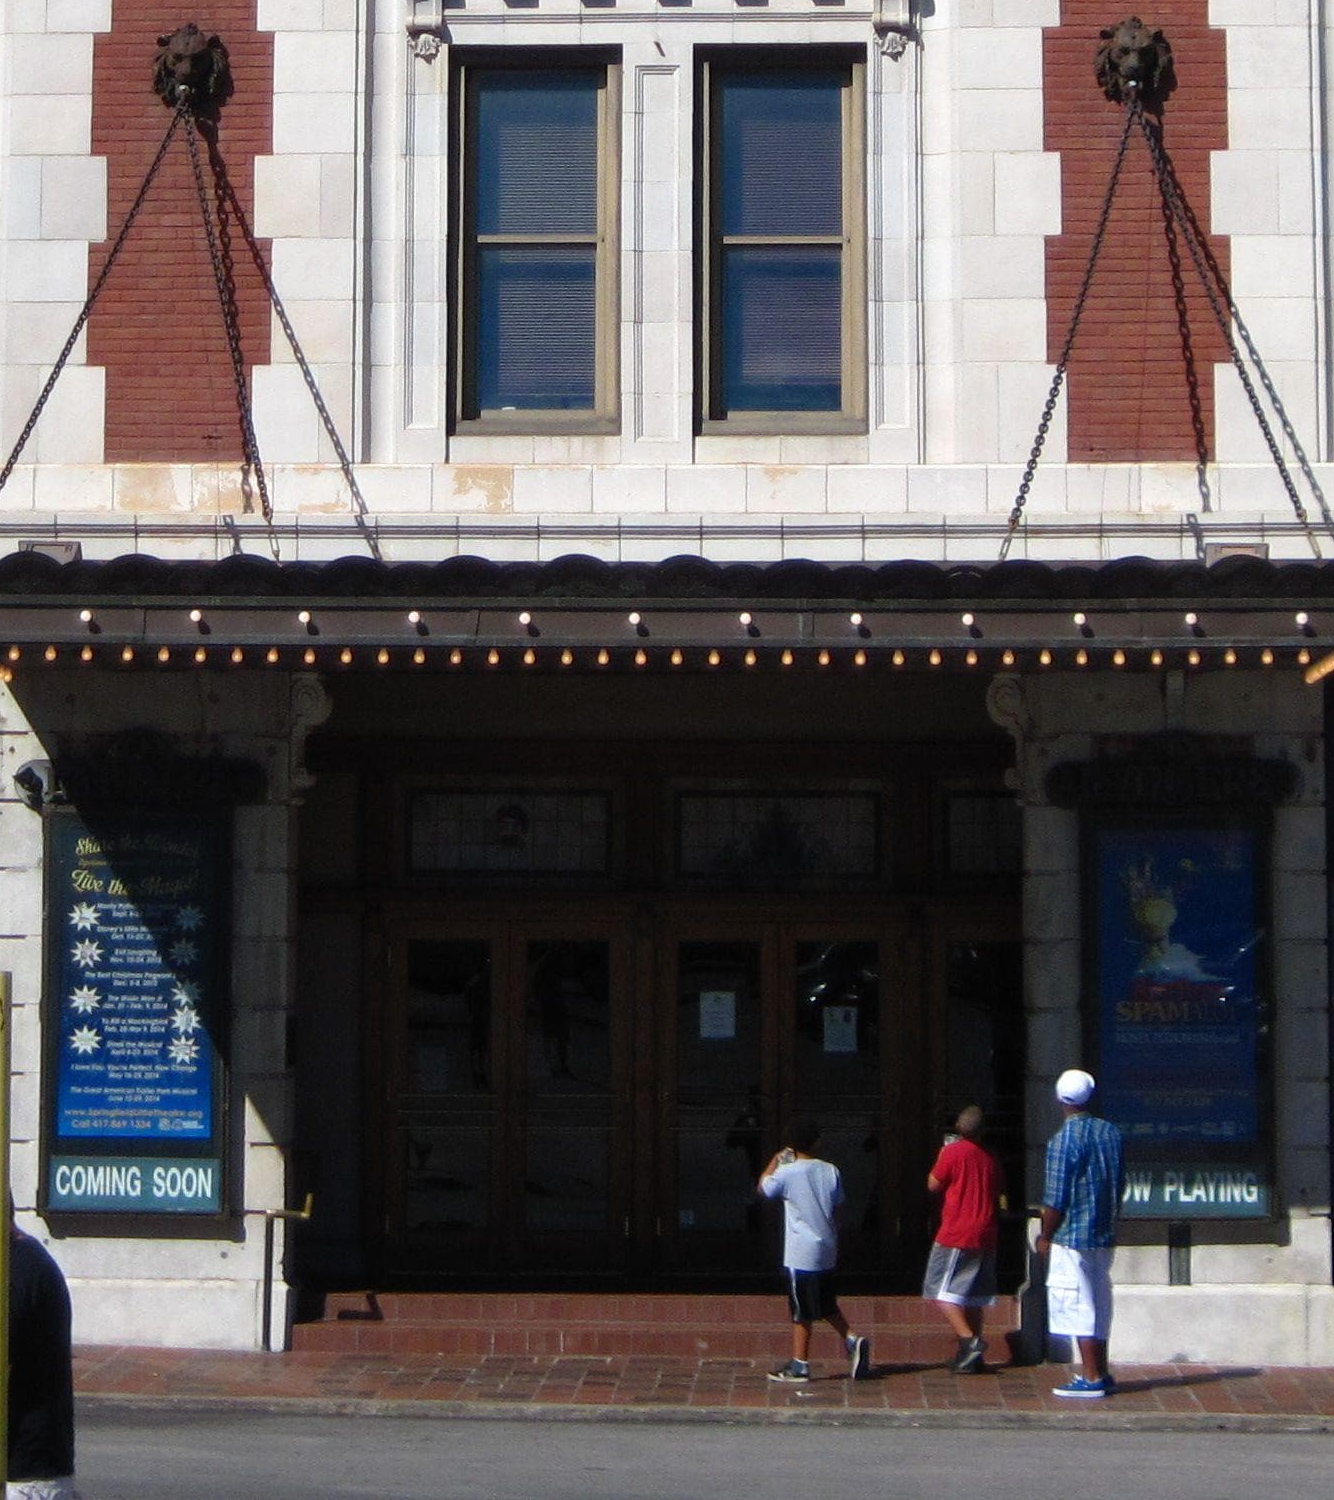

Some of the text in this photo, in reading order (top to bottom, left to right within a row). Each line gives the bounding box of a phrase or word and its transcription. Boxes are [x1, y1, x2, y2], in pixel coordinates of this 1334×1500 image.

[55, 1165, 212, 1198] COMING SOON
[1164, 1172, 1259, 1202] PLAYING
